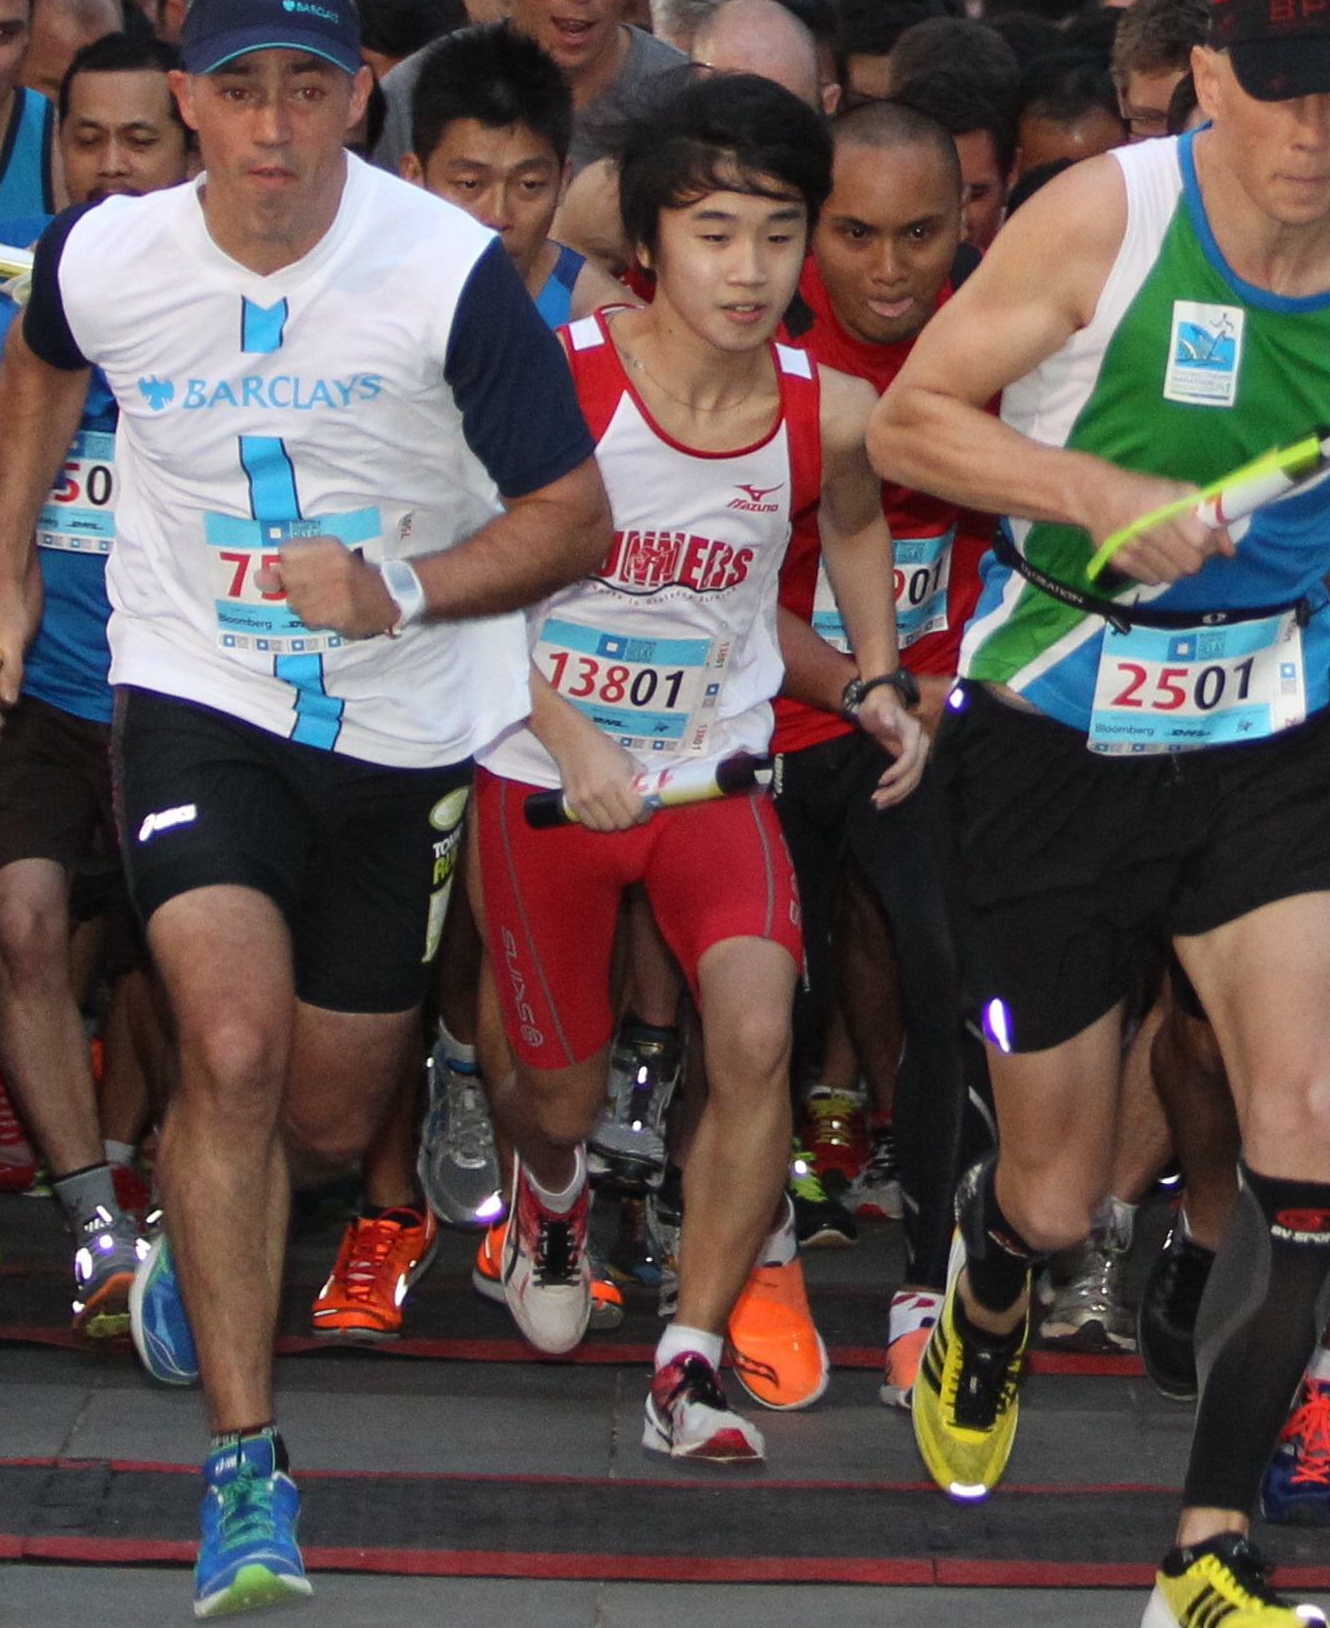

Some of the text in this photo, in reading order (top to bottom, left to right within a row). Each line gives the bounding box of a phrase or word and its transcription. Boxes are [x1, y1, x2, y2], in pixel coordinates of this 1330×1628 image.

[182, 372, 382, 410] BARCLAYS
[55, 462, 113, 506] 50
[219, 612, 273, 631] Bloomberg
[549, 651, 685, 709] 13801
[1109, 655, 1256, 712] 2501
[1095, 723, 1155, 738] Bloomberg
